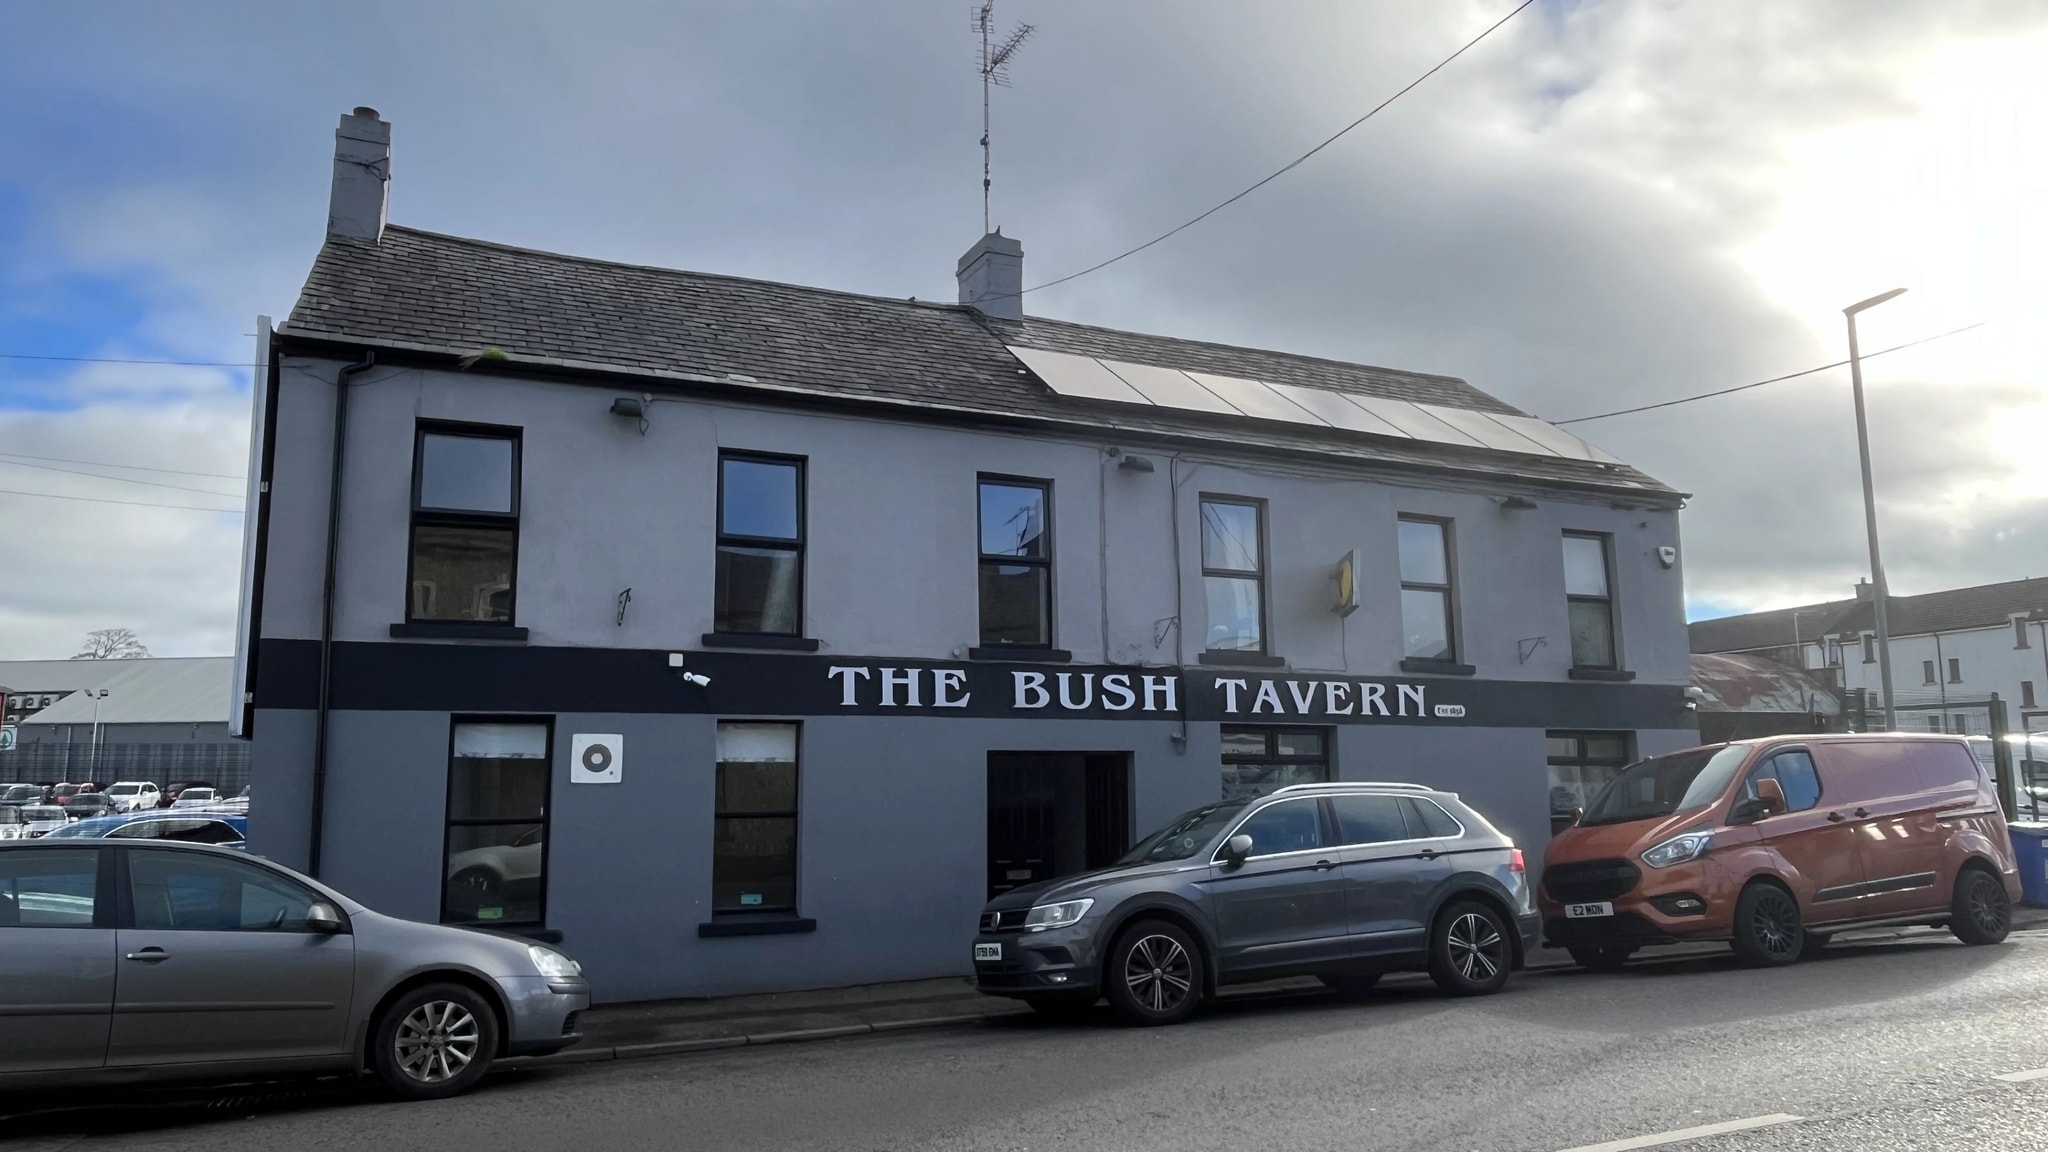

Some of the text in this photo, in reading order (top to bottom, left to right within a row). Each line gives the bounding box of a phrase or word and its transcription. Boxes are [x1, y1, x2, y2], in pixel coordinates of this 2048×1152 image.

[828, 666, 1427, 717] THE BUSH TAVERN
